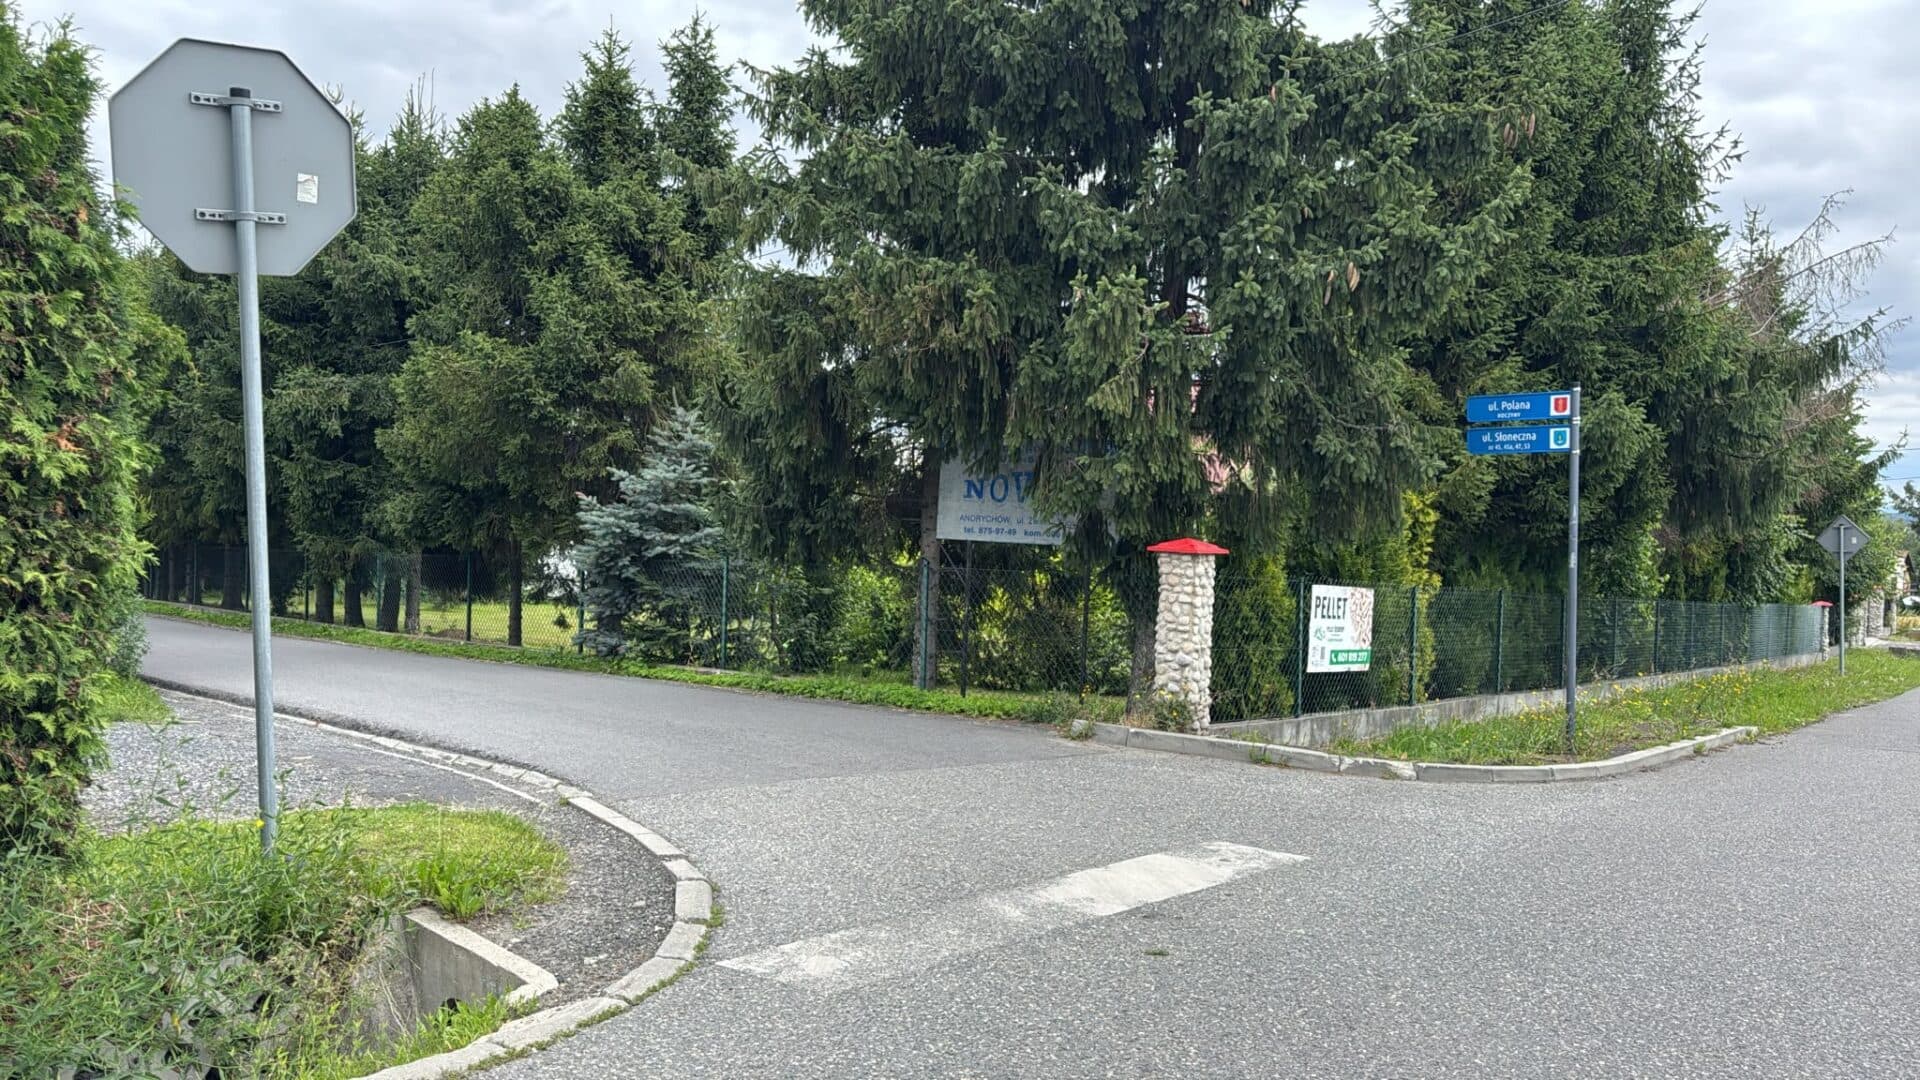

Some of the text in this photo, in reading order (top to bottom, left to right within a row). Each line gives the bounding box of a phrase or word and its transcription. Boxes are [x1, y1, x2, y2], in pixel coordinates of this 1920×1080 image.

[1488, 400, 1531, 411] ul. Polana
[1482, 432, 1537, 442] ul. Słoneczna
[1314, 596, 1348, 620] PELLET
